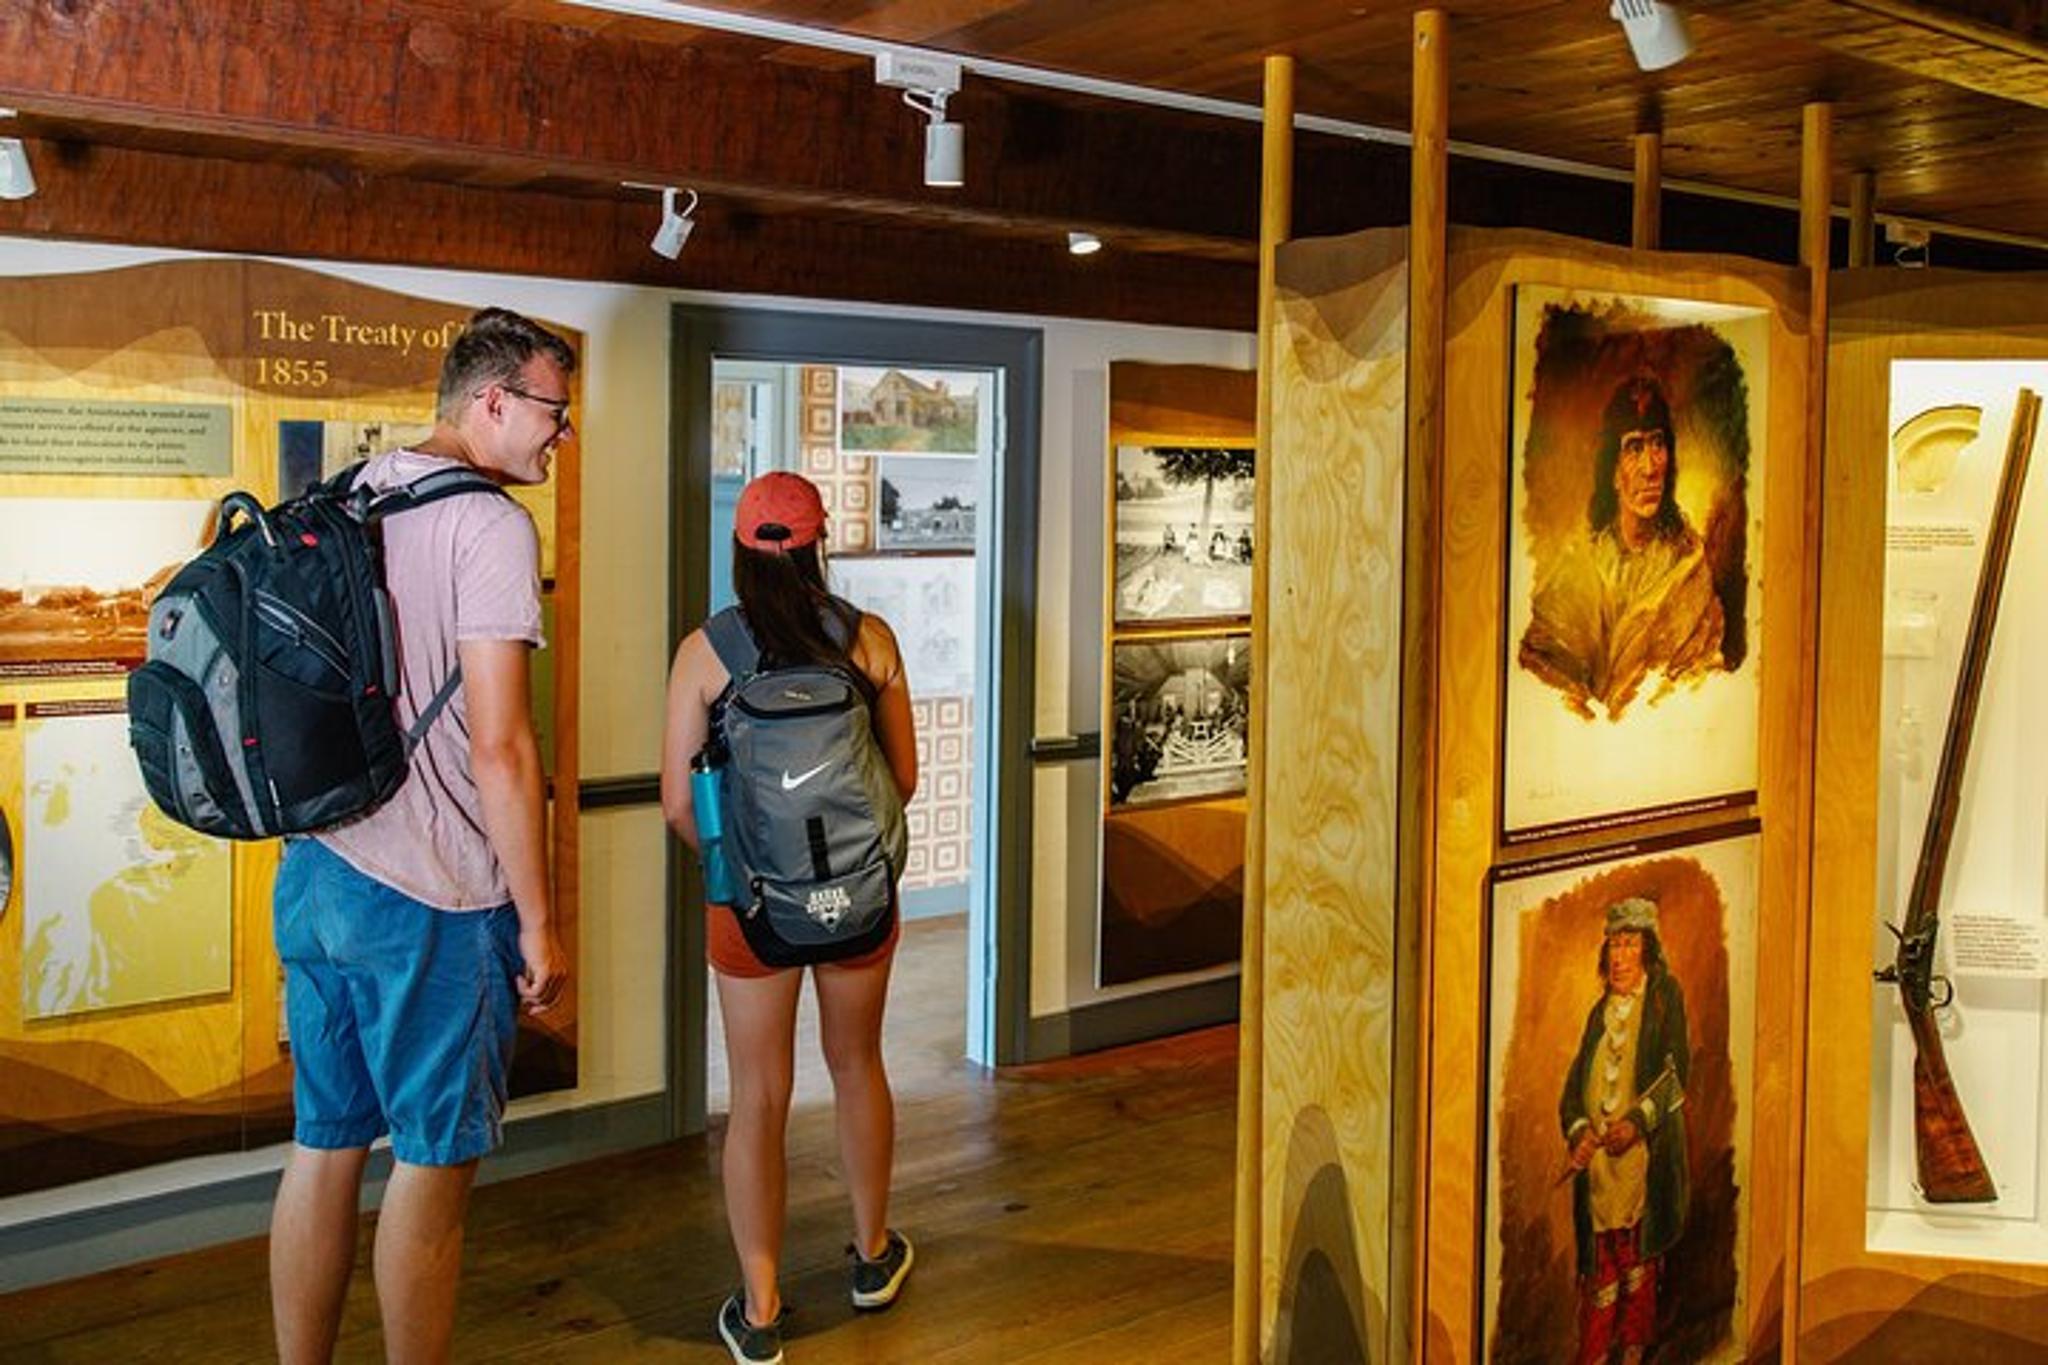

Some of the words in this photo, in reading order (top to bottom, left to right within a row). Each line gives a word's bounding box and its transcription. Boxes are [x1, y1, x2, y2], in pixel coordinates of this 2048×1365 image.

[252, 311, 315, 341] The
[321, 315, 416, 356] Treaty
[422, 321, 455, 348] of
[256, 357, 329, 387] 1855
